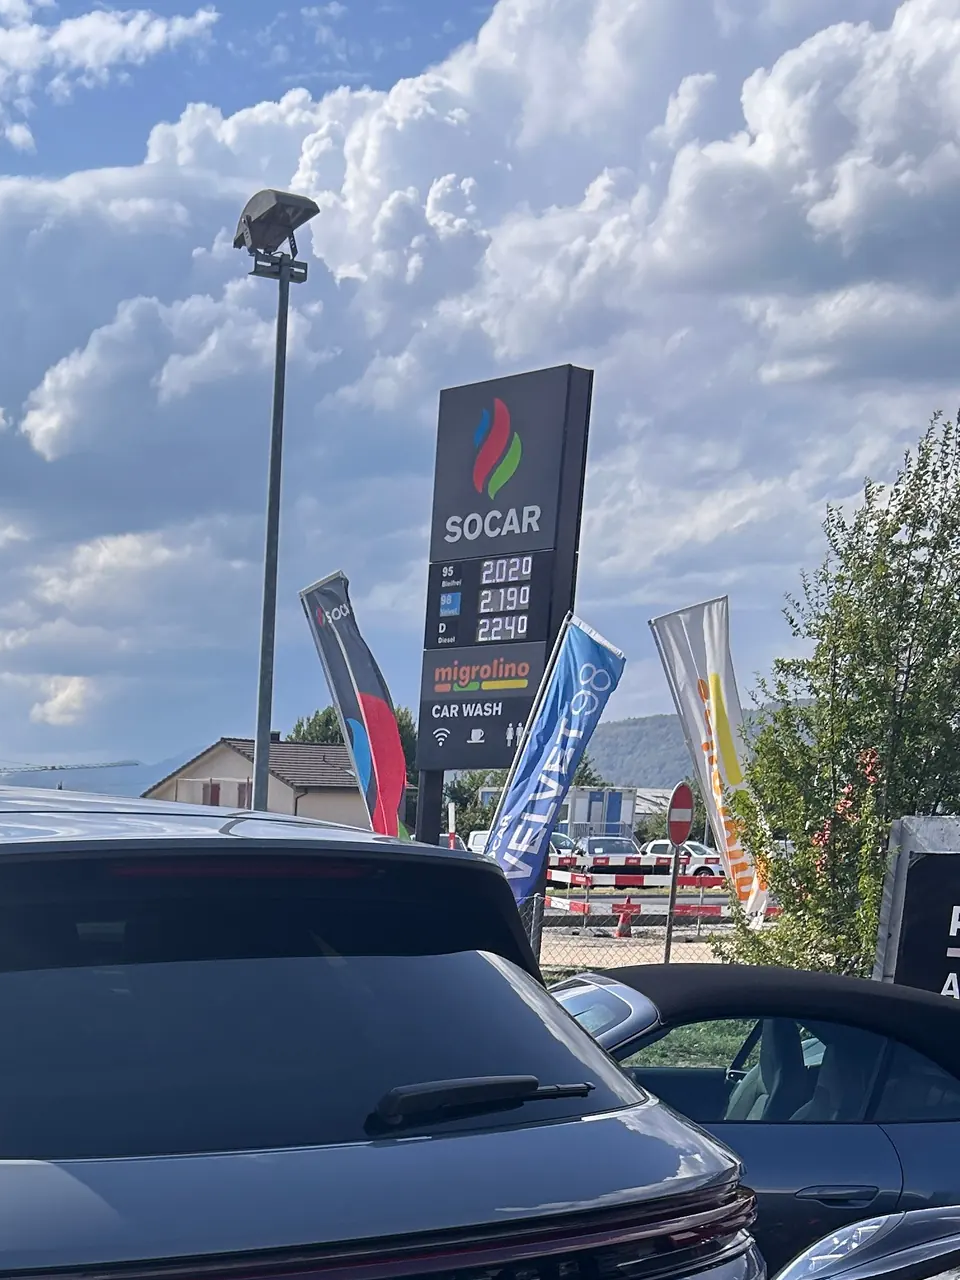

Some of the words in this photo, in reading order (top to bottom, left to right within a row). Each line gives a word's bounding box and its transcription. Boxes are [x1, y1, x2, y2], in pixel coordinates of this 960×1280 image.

[443, 504, 542, 543] SOCAR
[442, 566, 454, 577] 95
[440, 595, 452, 605] 98
[438, 622, 447, 634] D
[434, 657, 530, 687] migrolino
[570, 662, 612, 716] 98
[431, 704, 460, 719] CAR
[462, 702, 503, 717] WASH
